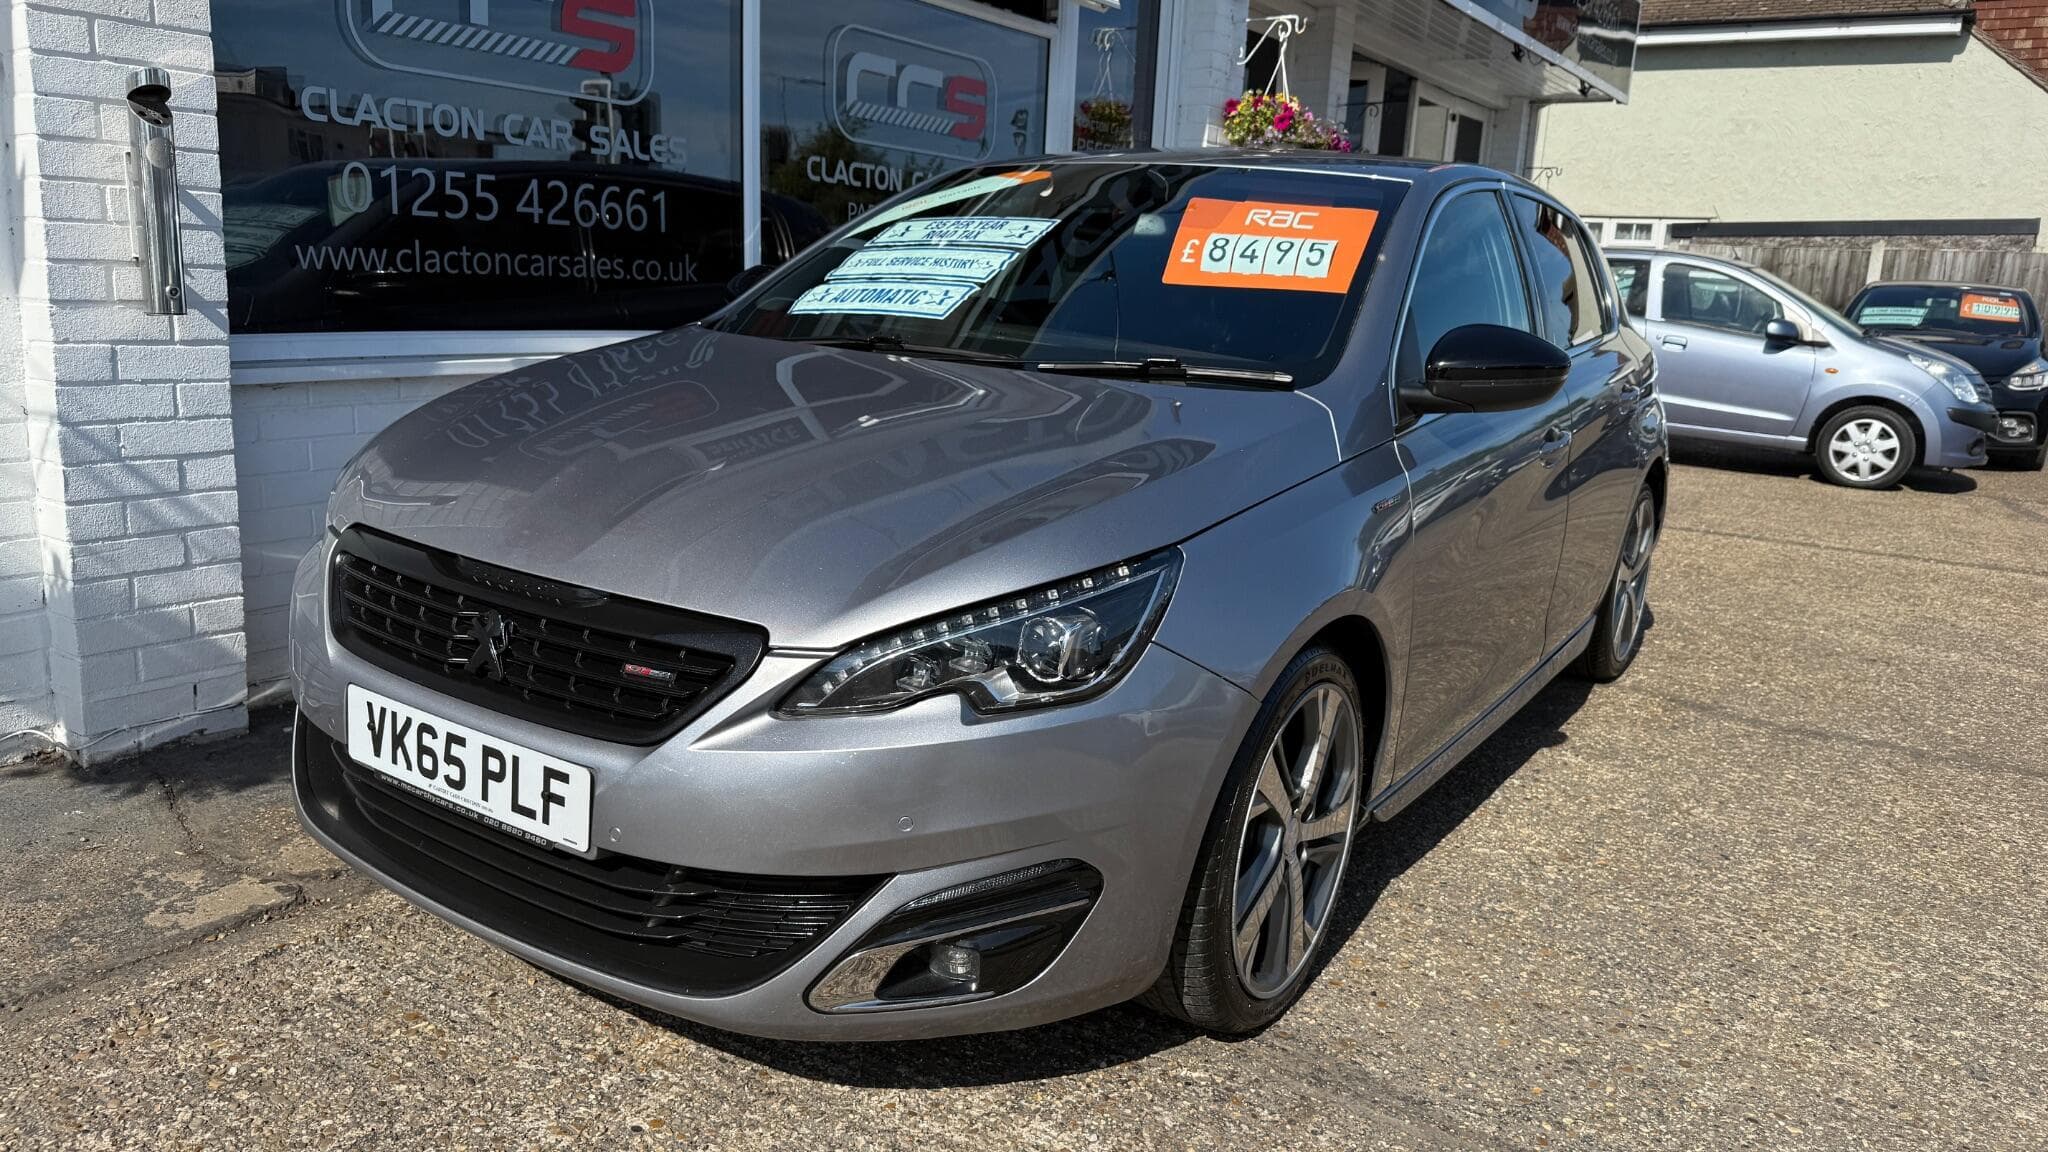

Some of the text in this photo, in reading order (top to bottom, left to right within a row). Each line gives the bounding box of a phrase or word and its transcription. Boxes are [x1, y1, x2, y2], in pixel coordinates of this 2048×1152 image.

[301, 85, 687, 164] CLACTON CAR SALES
[806, 155, 903, 192] CLACTON
[341, 161, 668, 233] 01255 426661
[950, 221, 972, 230] PER
[974, 221, 1009, 231] YEAR
[957, 231, 983, 240] TAX
[295, 240, 699, 283] www.clactoncarsales.co.uk
[887, 256, 932, 267] SERVICE
[831, 287, 926, 306] AUTOMATIC
[366, 701, 570, 826] VK65 PLF
